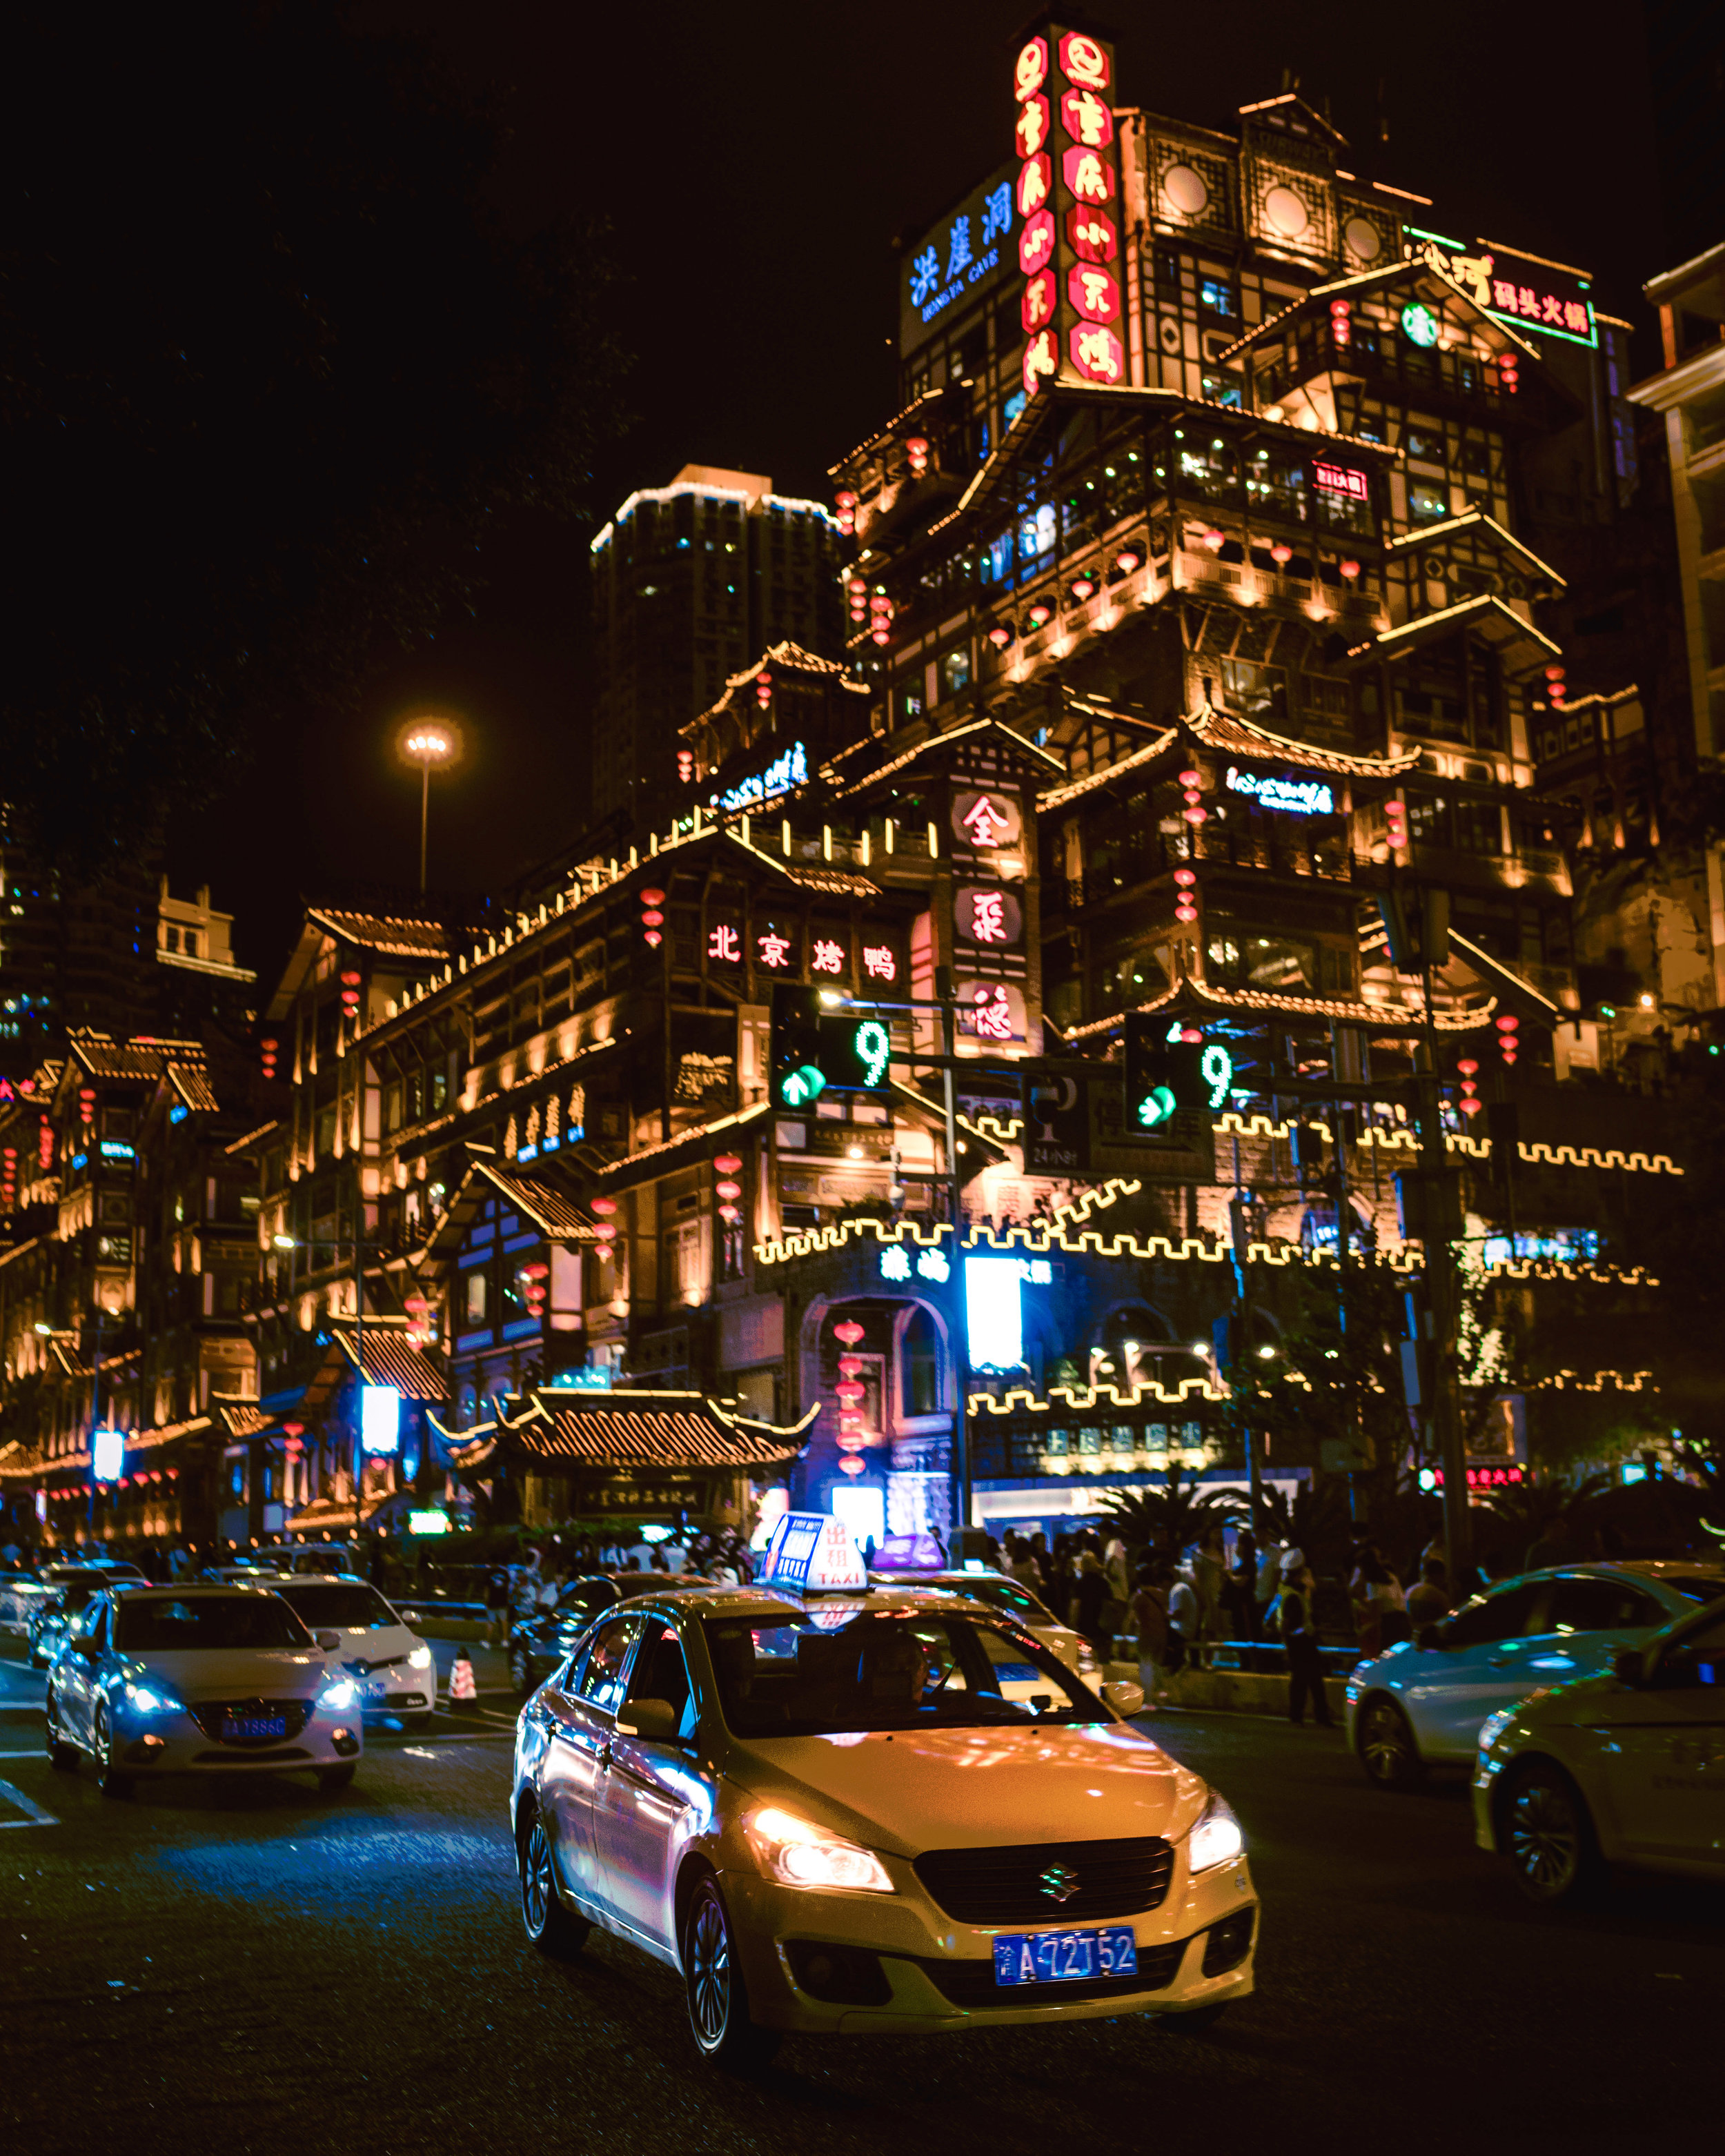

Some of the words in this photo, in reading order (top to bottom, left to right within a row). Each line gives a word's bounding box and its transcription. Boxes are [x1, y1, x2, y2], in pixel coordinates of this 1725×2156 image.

[909, 181, 1012, 308] 洪崖洞
[1492, 279, 1588, 334] 码头火锅
[708, 924, 896, 981] 北京烤鸭
[856, 1021, 889, 1087] 9
[1201, 1045, 1232, 1109] 9
[826, 1525, 849, 1567] 出租
[818, 1572, 860, 1585] TAXI
